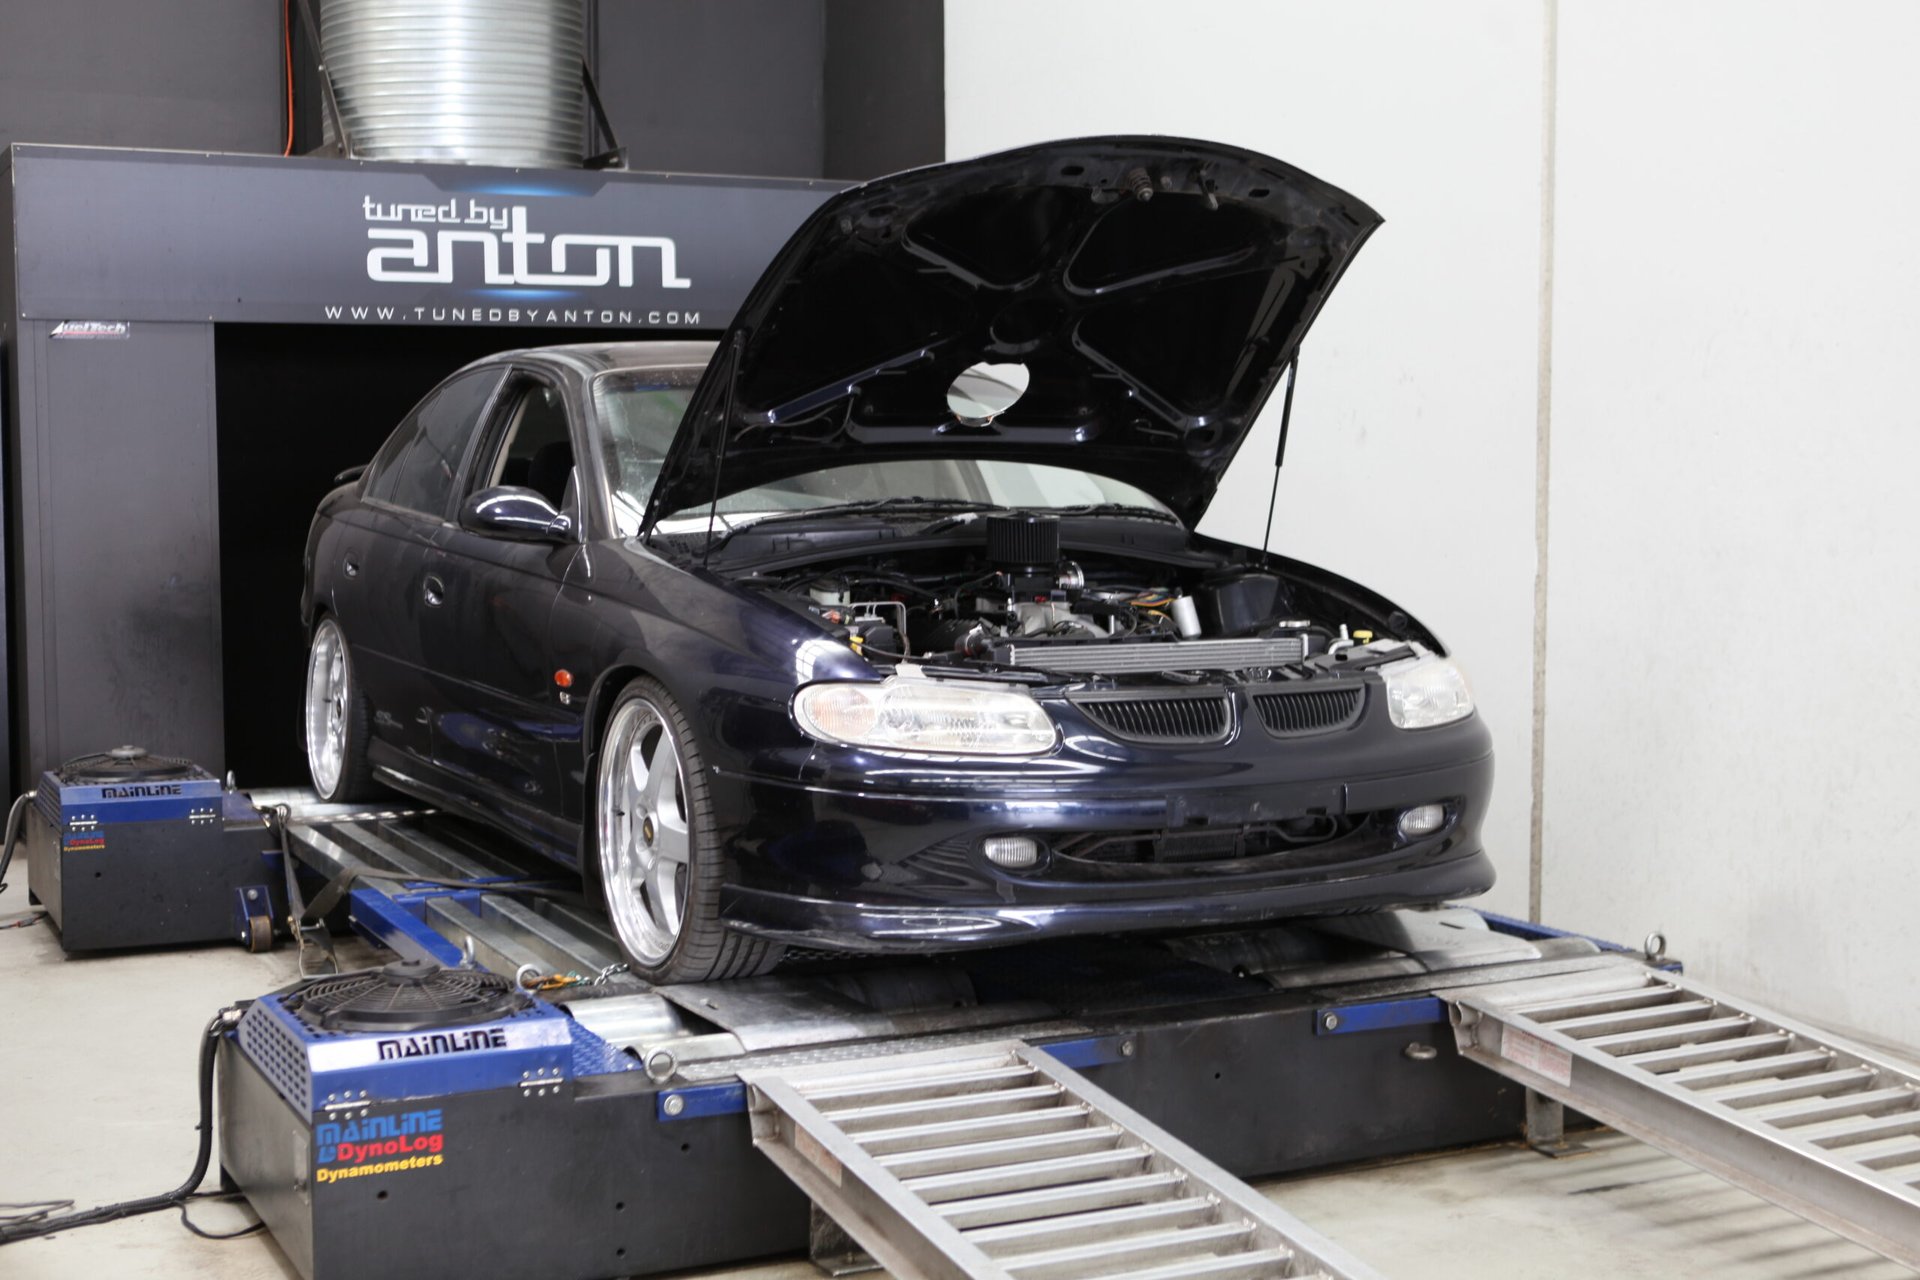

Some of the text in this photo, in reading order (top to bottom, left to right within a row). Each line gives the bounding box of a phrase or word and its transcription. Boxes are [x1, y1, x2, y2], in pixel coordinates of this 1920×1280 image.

[363, 195, 508, 230] tuned by
[367, 206, 692, 288] anton
[324, 306, 701, 325] WWW.TUNEDBYANTON.COM
[316, 1154, 444, 1184] Dynamometers
